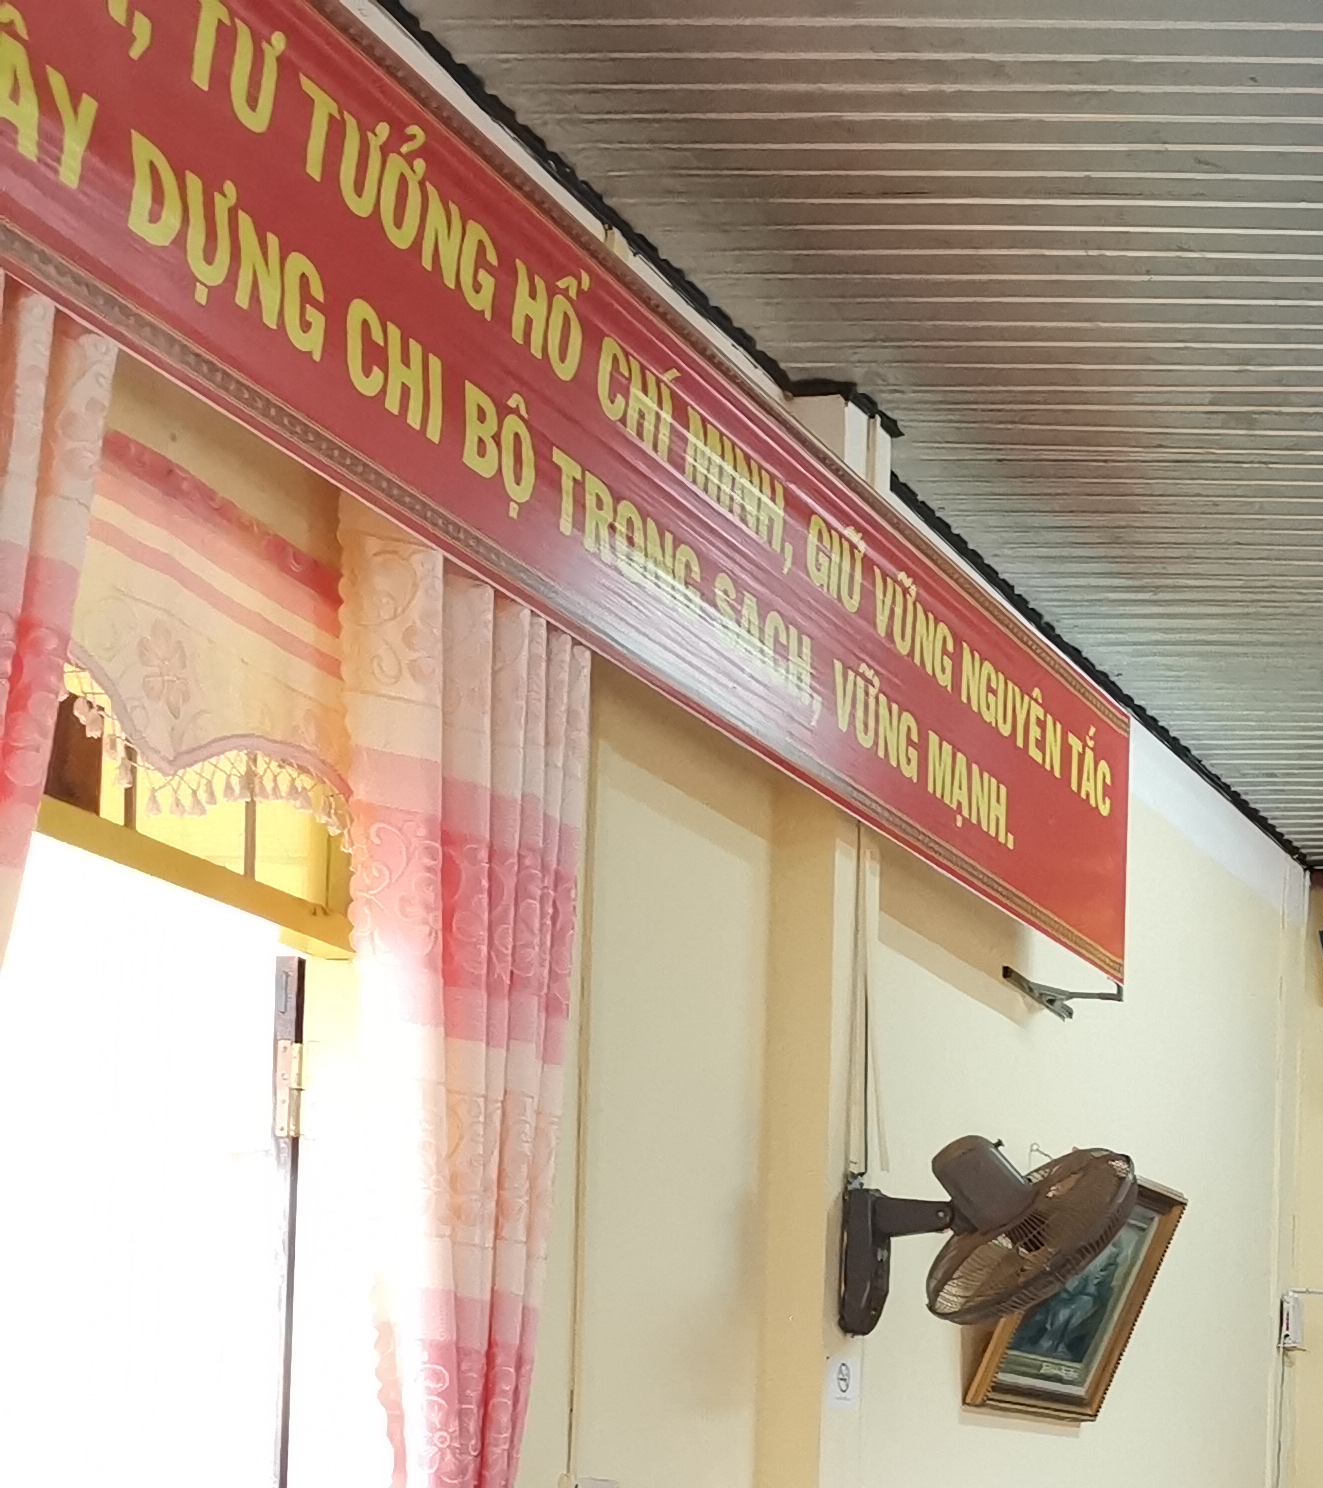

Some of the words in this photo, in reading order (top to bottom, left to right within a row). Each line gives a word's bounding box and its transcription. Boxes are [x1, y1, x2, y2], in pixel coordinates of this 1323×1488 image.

[127, 129, 325, 362] DỰNG
[346, 299, 442, 444] CHI
[462, 380, 535, 519] BỘ
[553, 446, 702, 627] TRONG
[834, 661, 919, 783] VỮNG
[927, 730, 1014, 850] MẠNH.
[299, 72, 498, 321] TƯỞNG
[598, 336, 681, 462] CHÍ
[684, 406, 793, 575] MINH,
[806, 514, 866, 613] GIỮ
[873, 571, 954, 693] VỮNG
[961, 641, 1062, 778] NGUYÊN
[1067, 726, 1112, 817] TẮC
